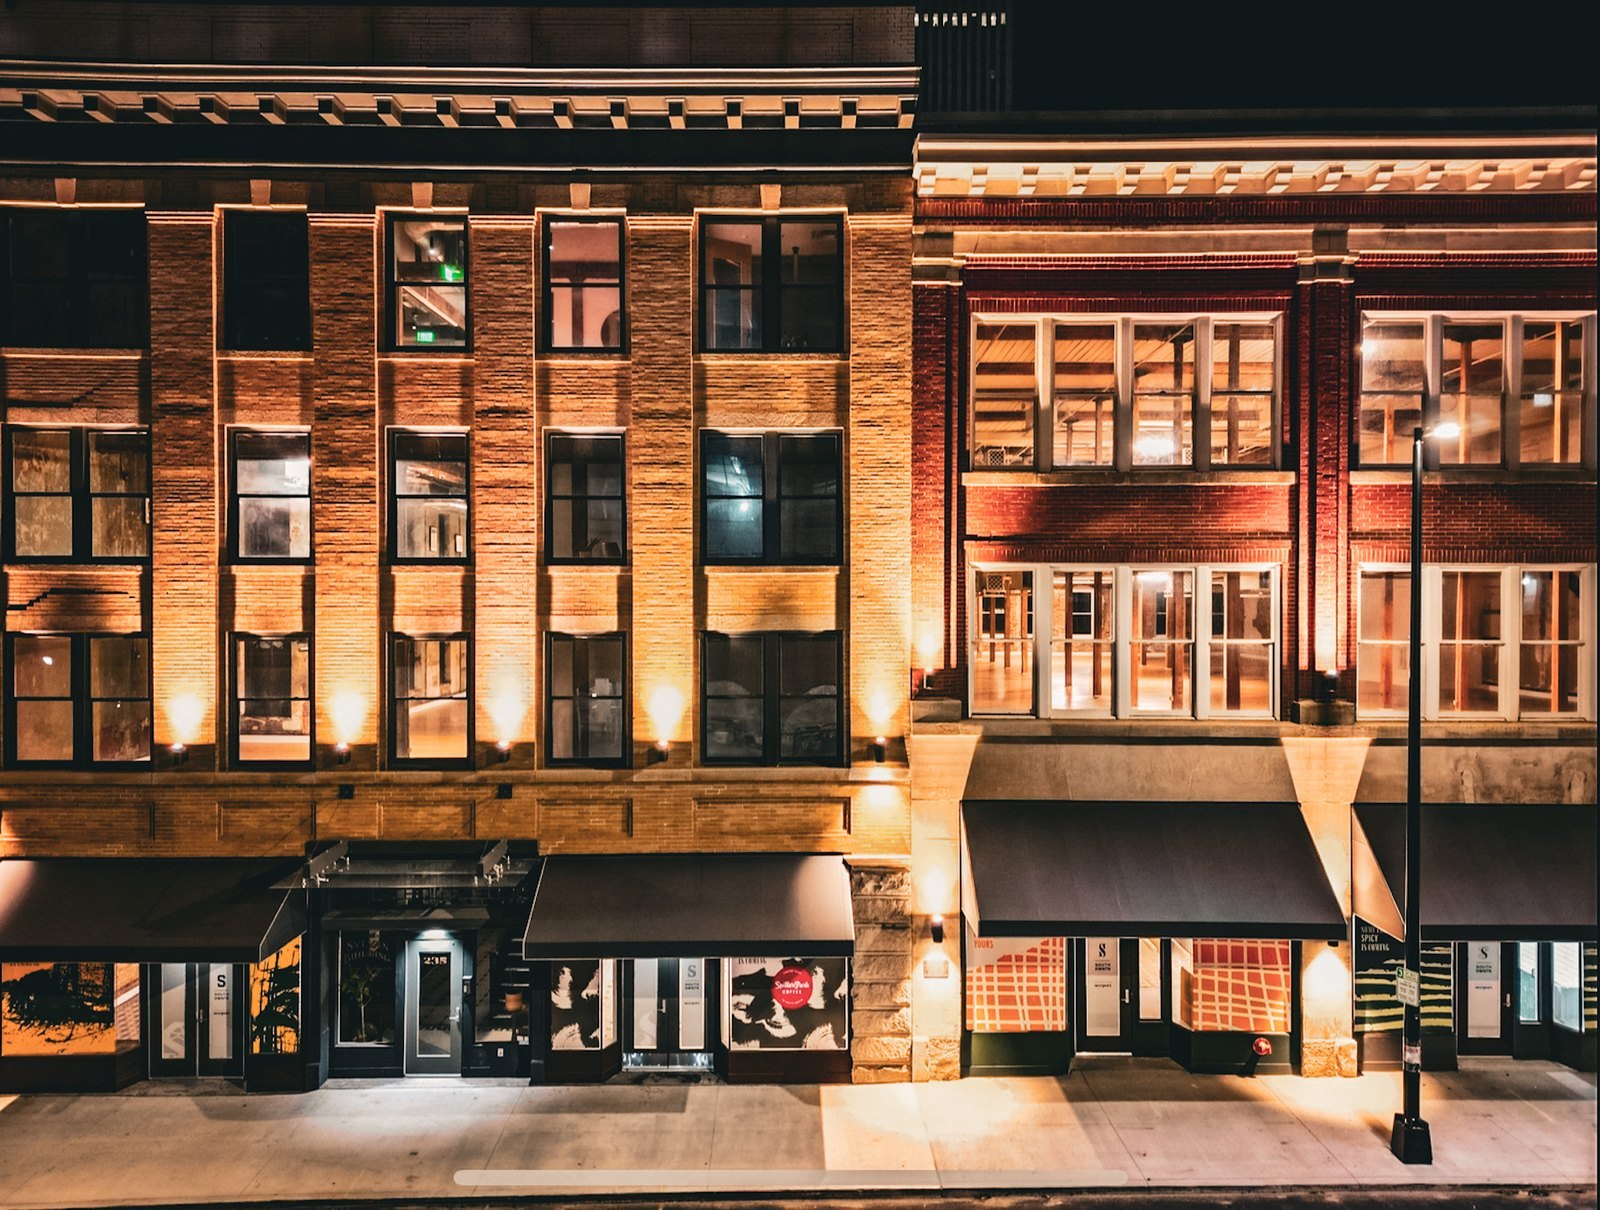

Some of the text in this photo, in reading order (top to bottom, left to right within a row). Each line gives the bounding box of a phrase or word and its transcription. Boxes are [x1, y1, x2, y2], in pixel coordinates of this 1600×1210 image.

[974, 939, 993, 948] YOURS
[1361, 934, 1378, 942] SPICY
[1098, 943, 1106, 958] S
[687, 964, 697, 978] S
[217, 974, 226, 988] S
